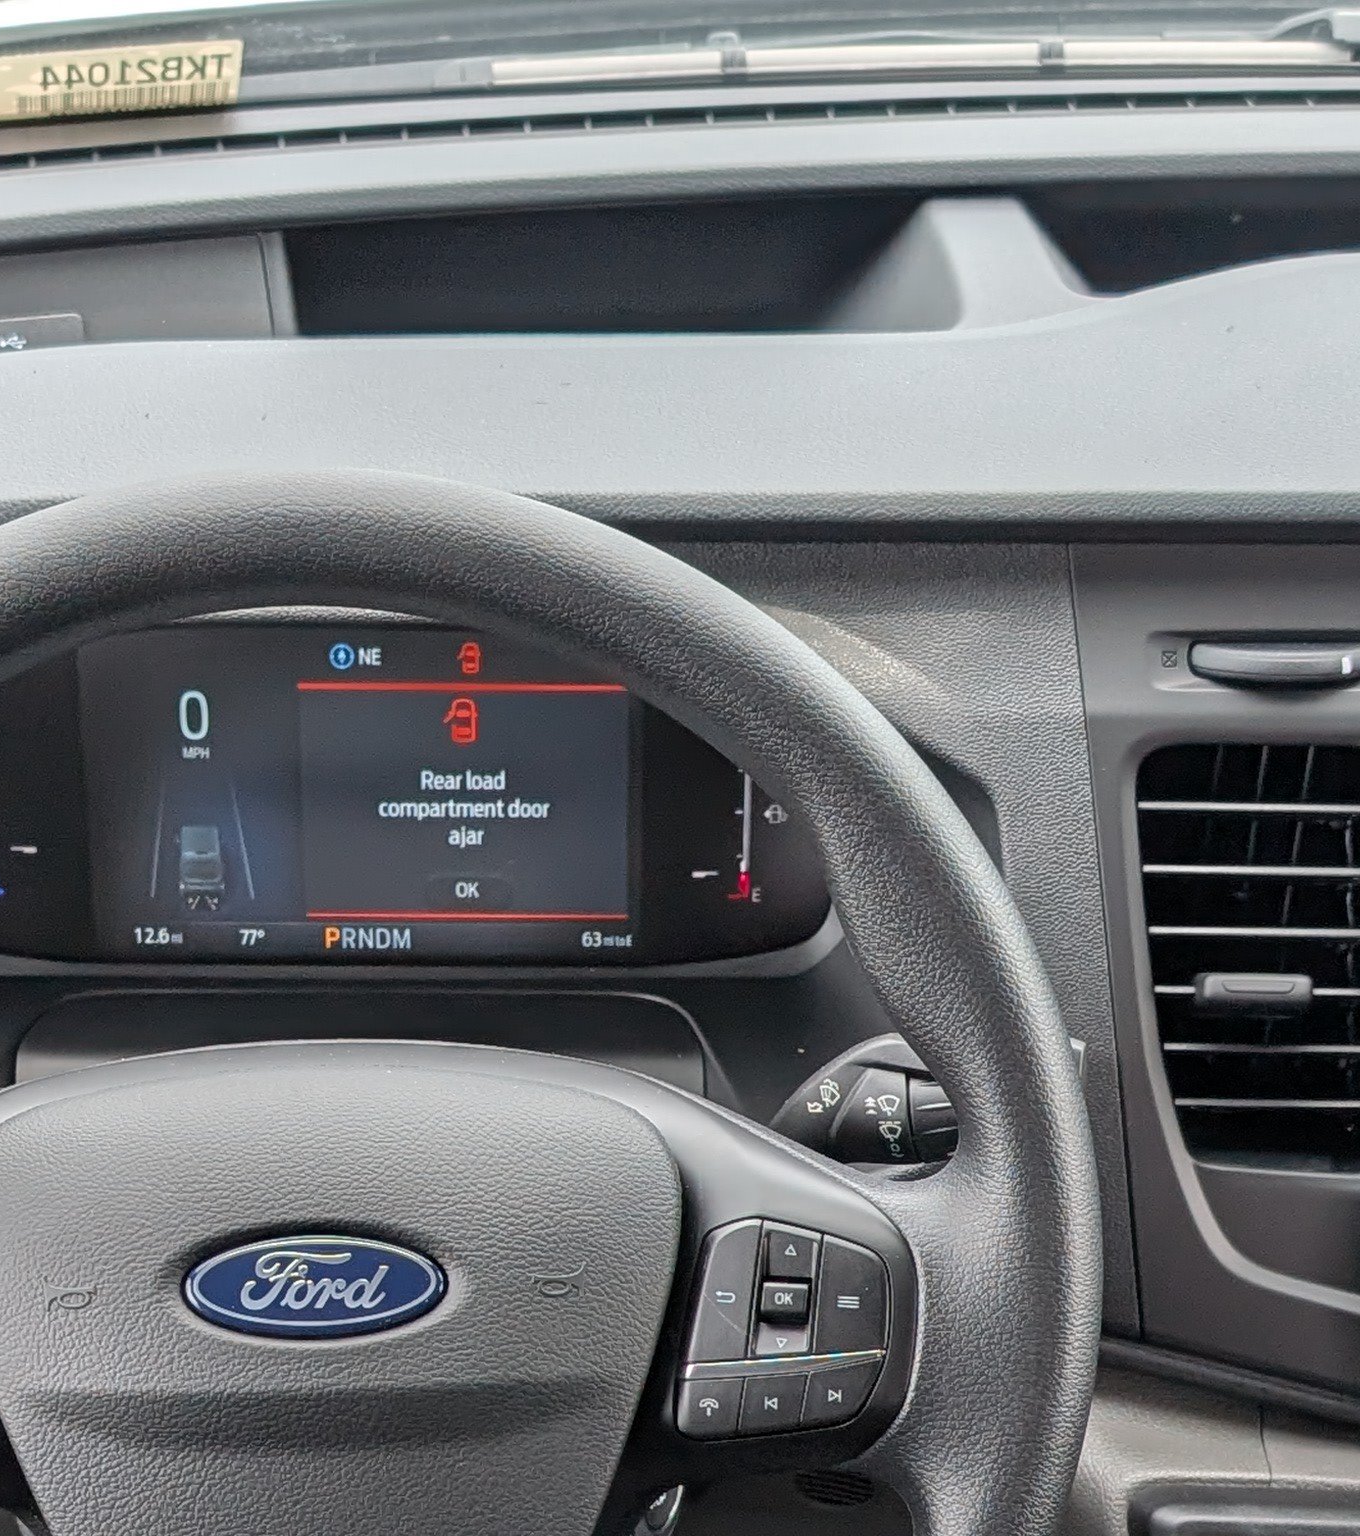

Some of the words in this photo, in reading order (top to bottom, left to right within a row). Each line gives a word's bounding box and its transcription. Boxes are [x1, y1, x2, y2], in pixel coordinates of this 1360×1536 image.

[358, 648, 382, 667] NE
[178, 690, 210, 740] 0
[182, 747, 210, 759] MPH
[420, 770, 463, 791] Rear
[465, 770, 506, 791] load
[378, 800, 504, 820] compartment
[506, 799, 551, 818] door
[448, 827, 485, 849] ajar
[455, 881, 479, 899] OK
[752, 887, 762, 903] E
[134, 927, 170, 945] 12.6
[581, 931, 602, 949] 63
[240, 1250, 389, 1312] Ford
[775, 1292, 793, 1305] OK
